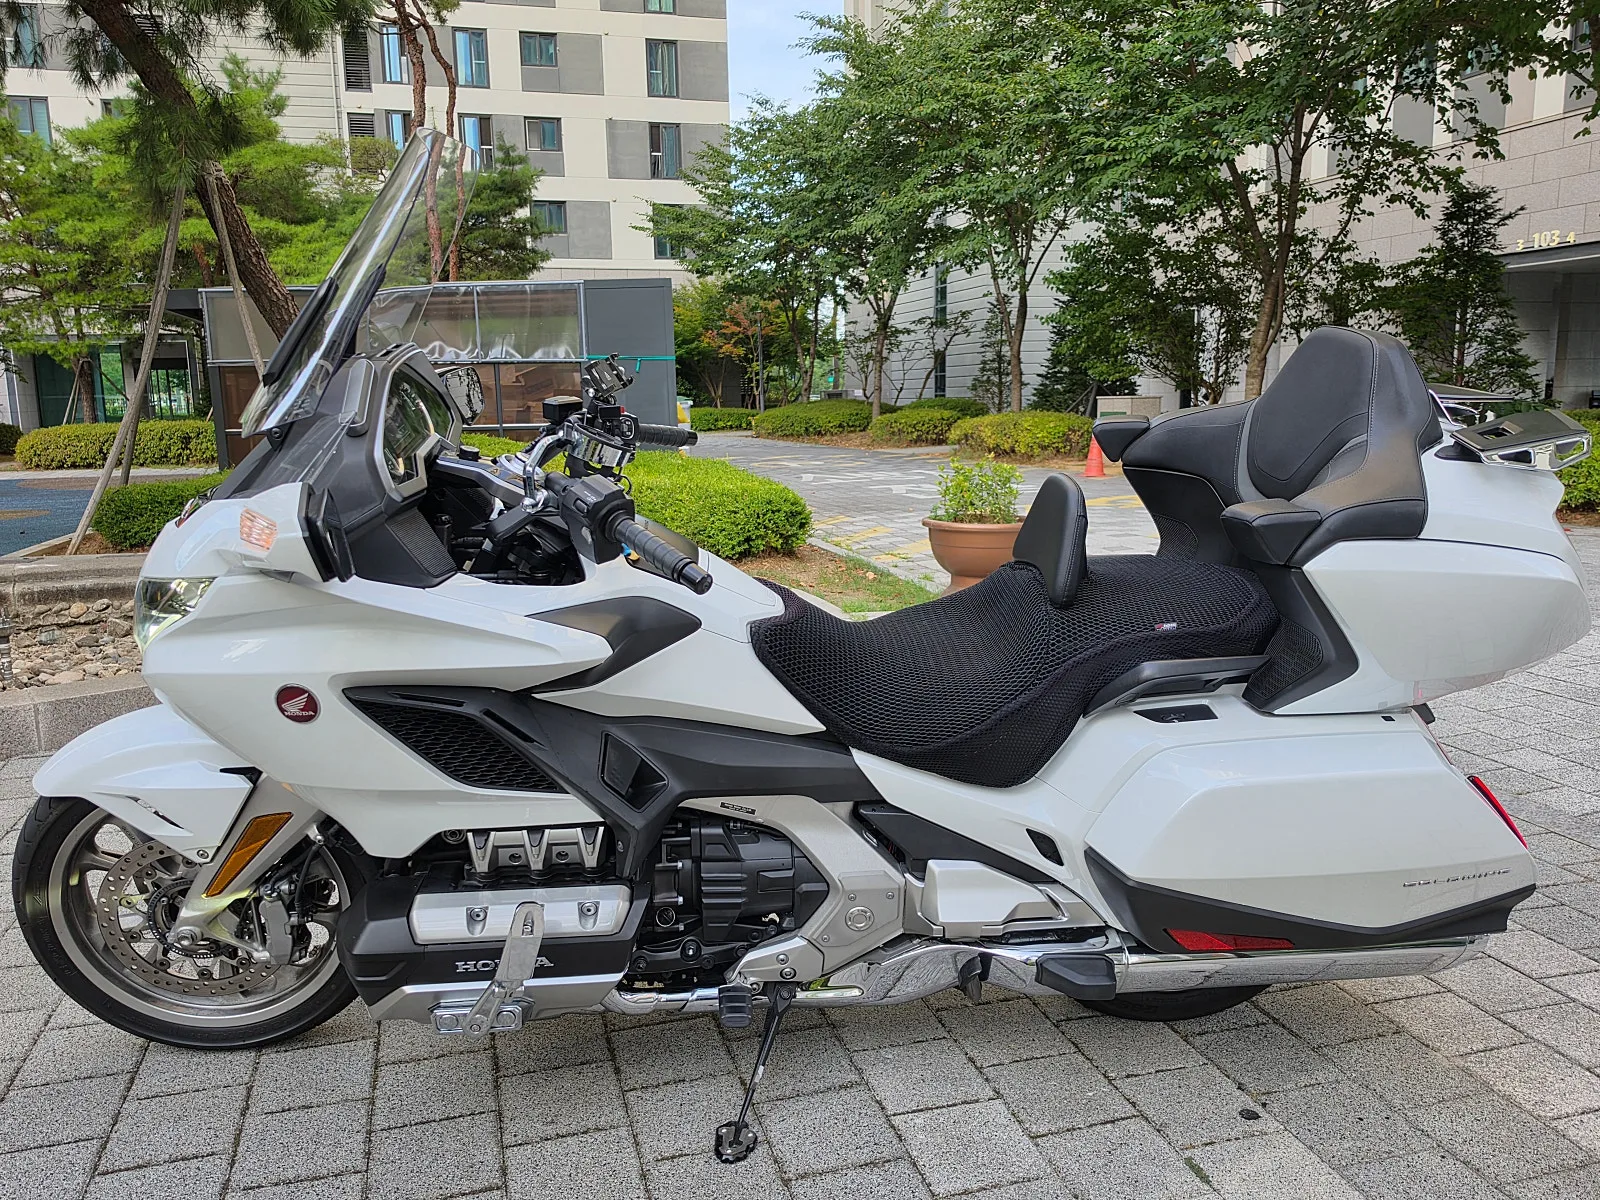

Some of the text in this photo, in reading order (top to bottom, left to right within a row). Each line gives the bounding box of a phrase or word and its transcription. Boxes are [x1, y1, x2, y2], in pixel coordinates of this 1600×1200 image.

[1516, 229, 1576, 251] 3 103 4
[454, 956, 555, 973] HOA
